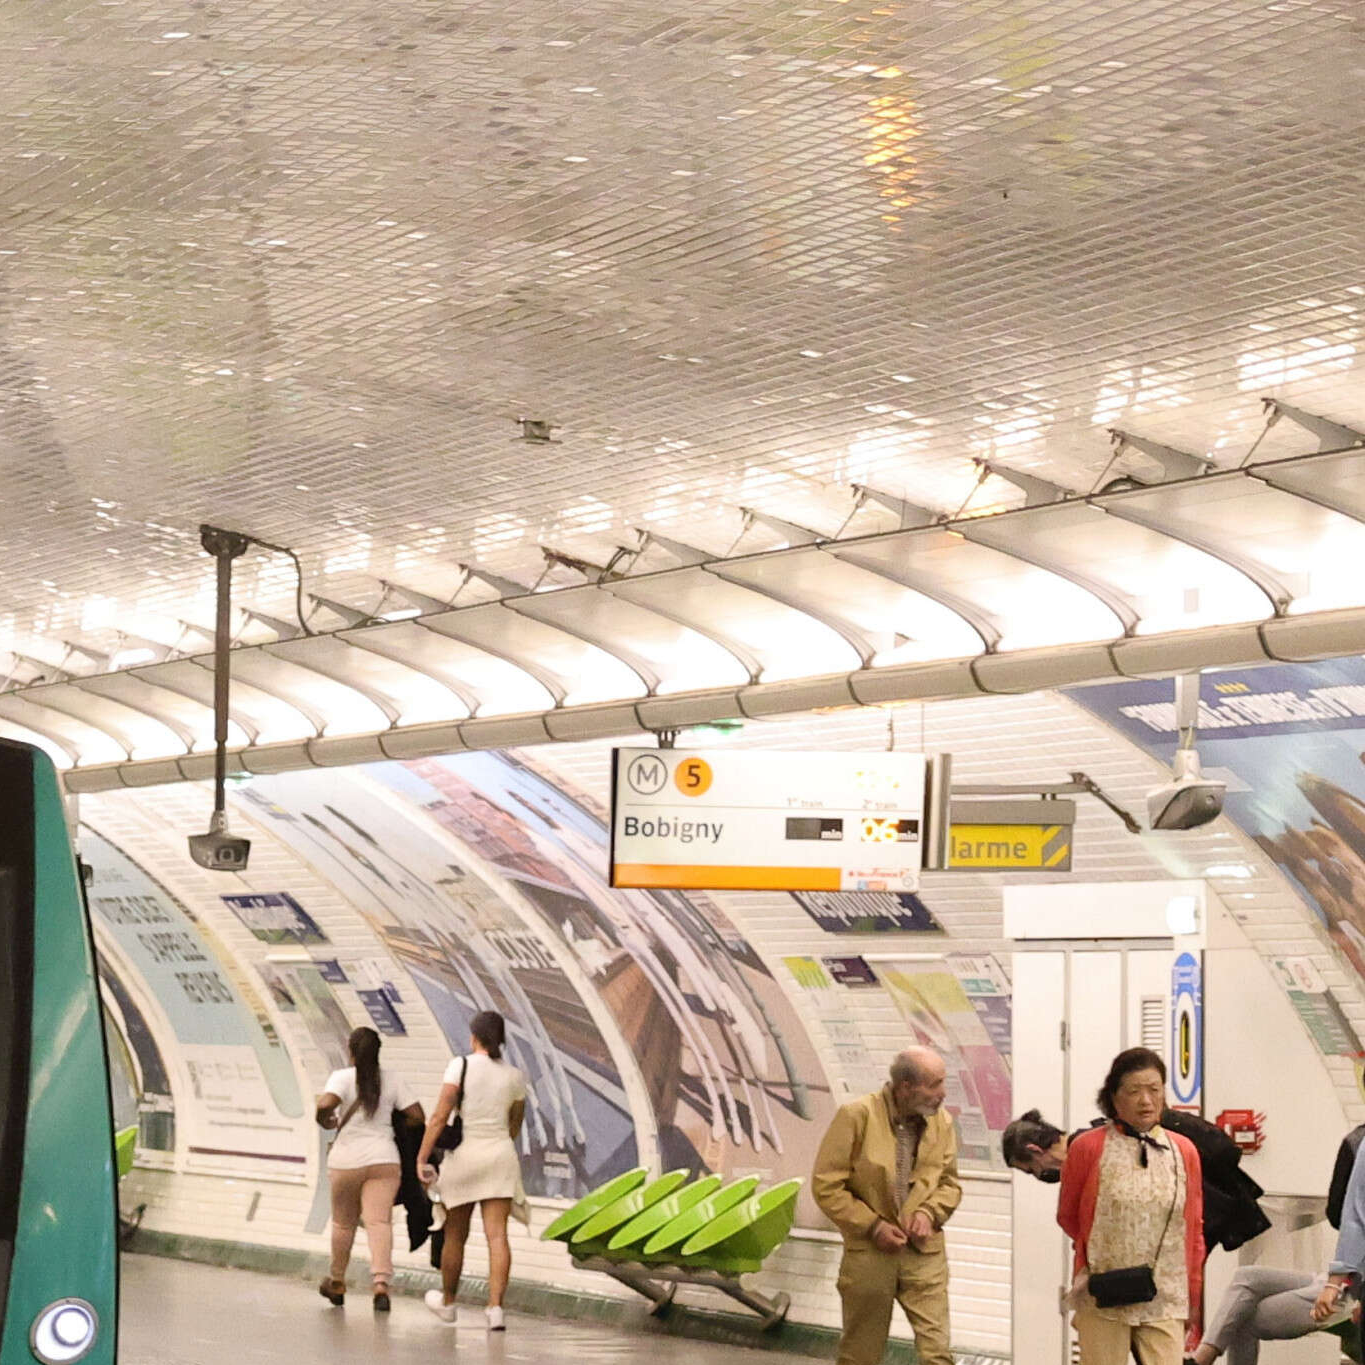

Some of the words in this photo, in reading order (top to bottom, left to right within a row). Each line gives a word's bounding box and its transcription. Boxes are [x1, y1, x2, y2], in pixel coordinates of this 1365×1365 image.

[685, 764, 702, 789] 5
[624, 816, 724, 843] Bobigny
[820, 829, 842, 839] min
[861, 818, 900, 842] 06
[950, 836, 1028, 860] larme
